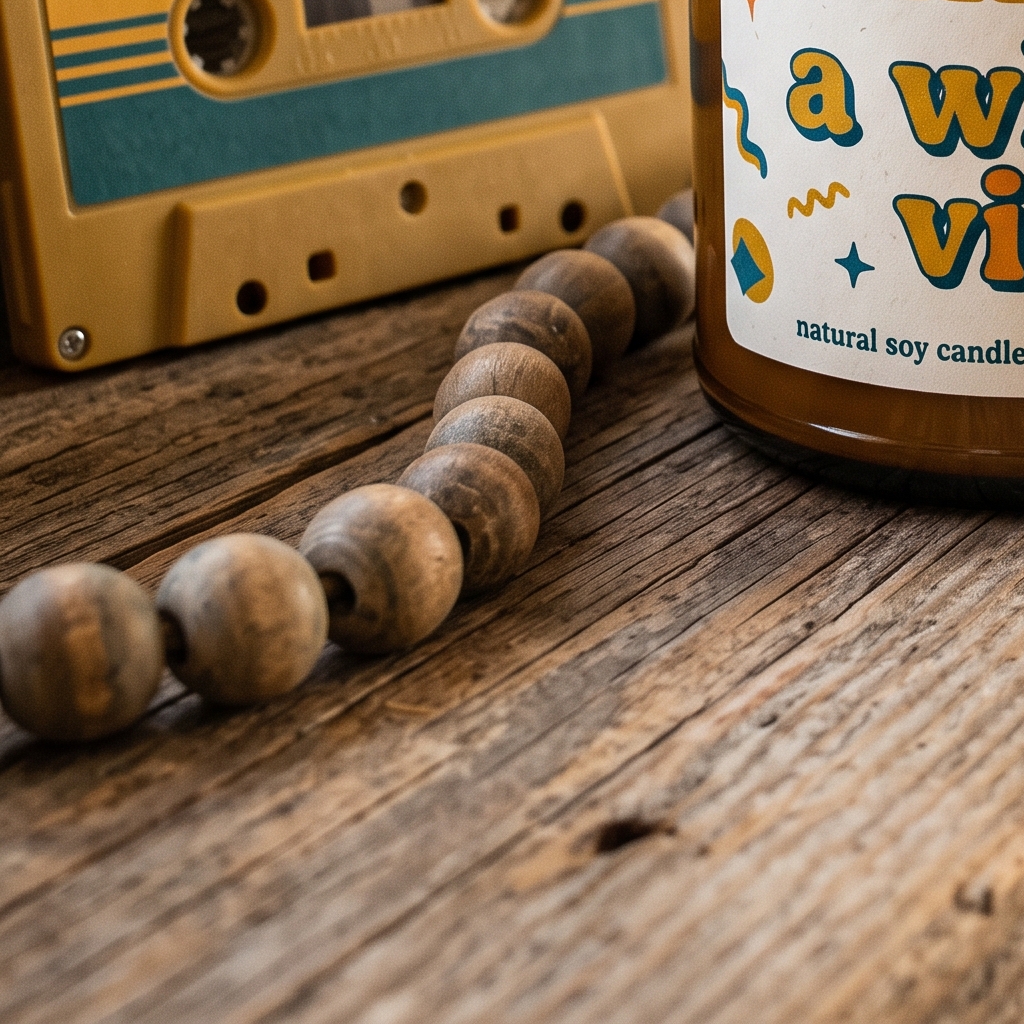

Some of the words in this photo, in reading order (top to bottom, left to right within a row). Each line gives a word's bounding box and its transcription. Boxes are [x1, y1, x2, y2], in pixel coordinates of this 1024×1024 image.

[786, 47, 864, 147] a
[797, 316, 878, 353] natural
[885, 337, 929, 365] soy
